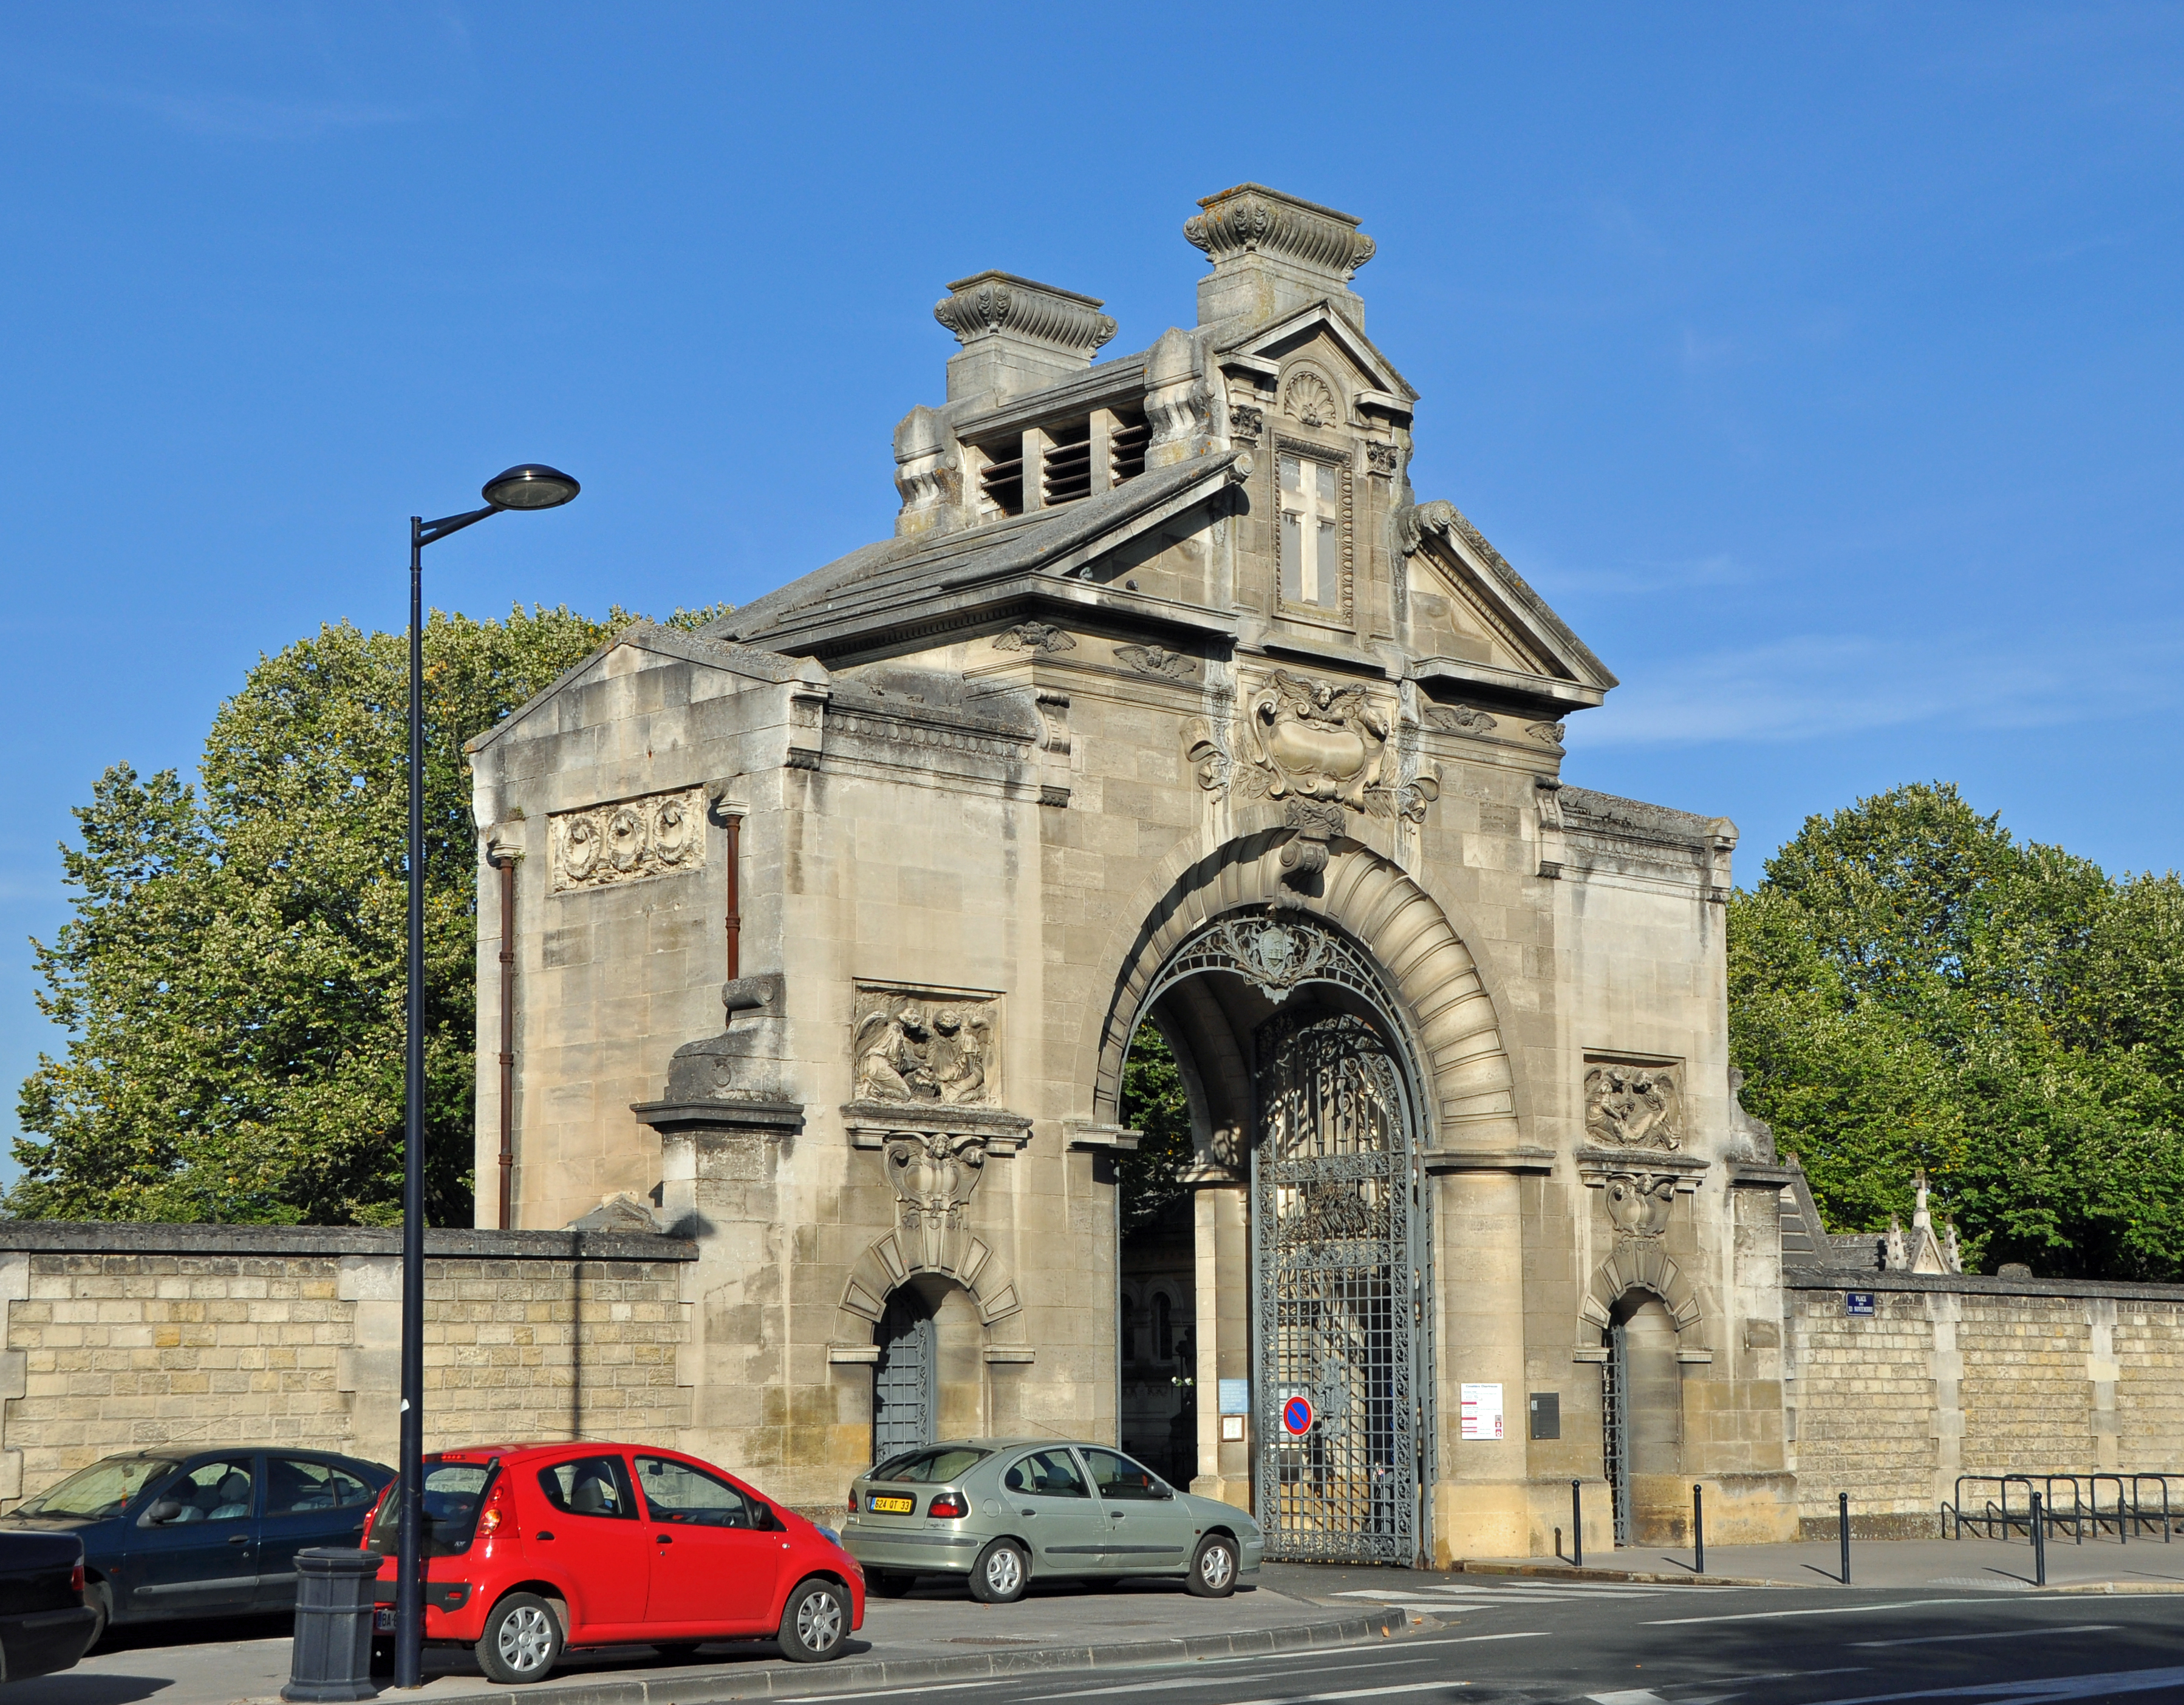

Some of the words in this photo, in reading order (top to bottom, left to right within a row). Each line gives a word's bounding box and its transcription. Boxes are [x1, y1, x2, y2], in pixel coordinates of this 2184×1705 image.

[875, 1499, 887, 1509] 624
[889, 1500, 898, 1509] QT
[901, 1501, 909, 1510] 33
